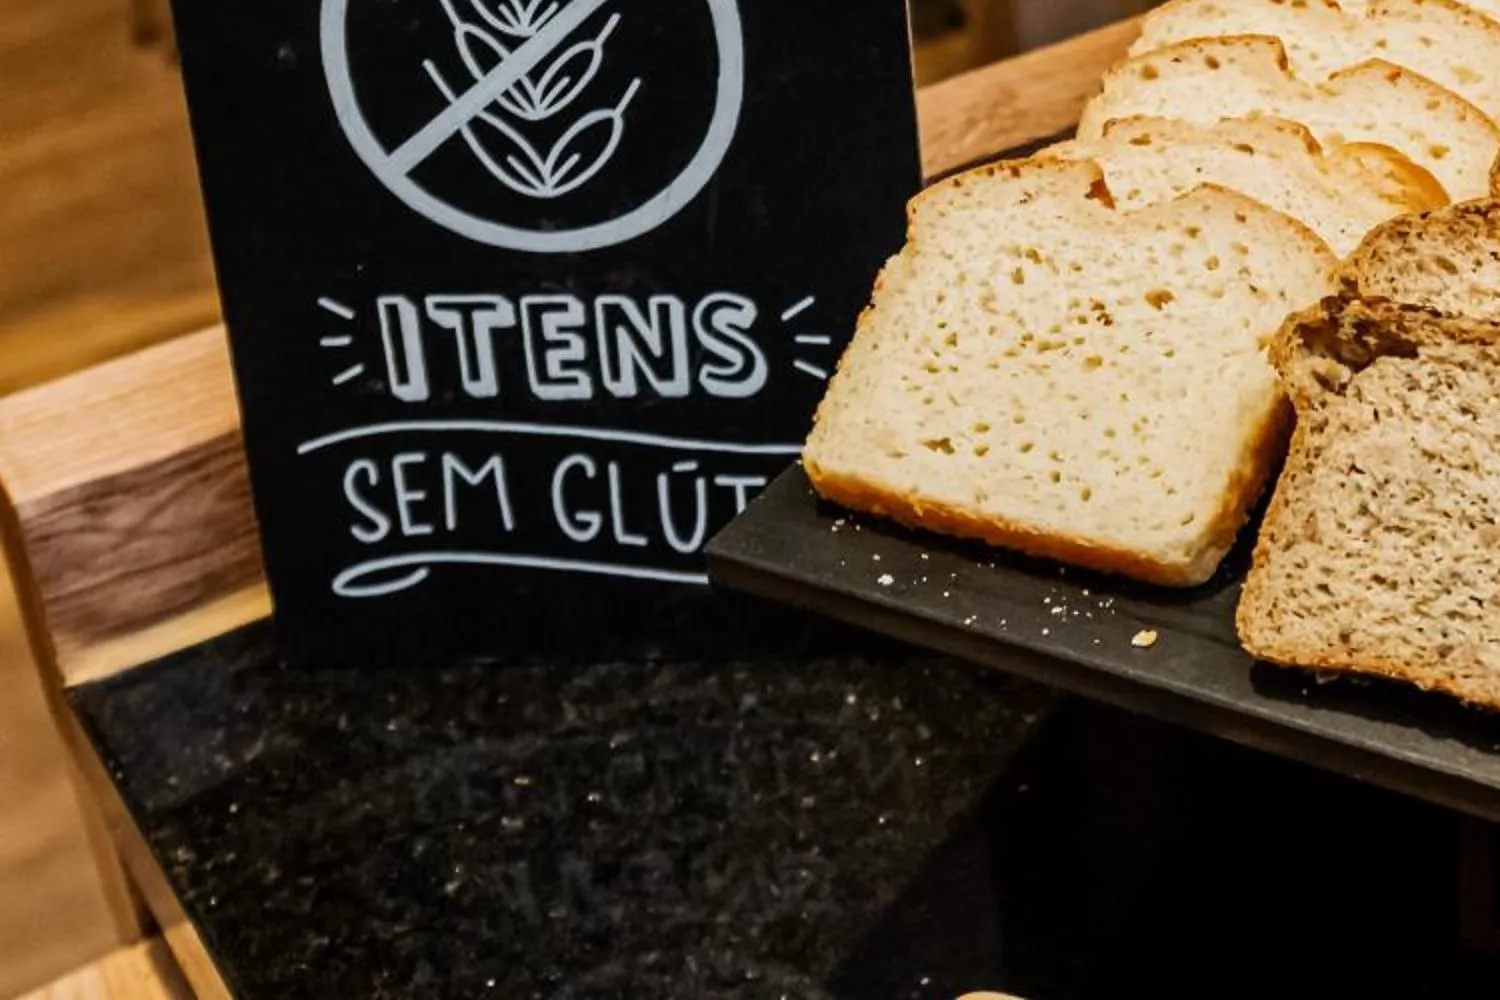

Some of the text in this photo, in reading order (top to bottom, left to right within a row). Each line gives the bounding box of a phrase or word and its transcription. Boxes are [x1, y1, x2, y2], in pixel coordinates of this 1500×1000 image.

[377, 291, 769, 402] ITENS
[343, 452, 768, 554] SEM GLÚT
